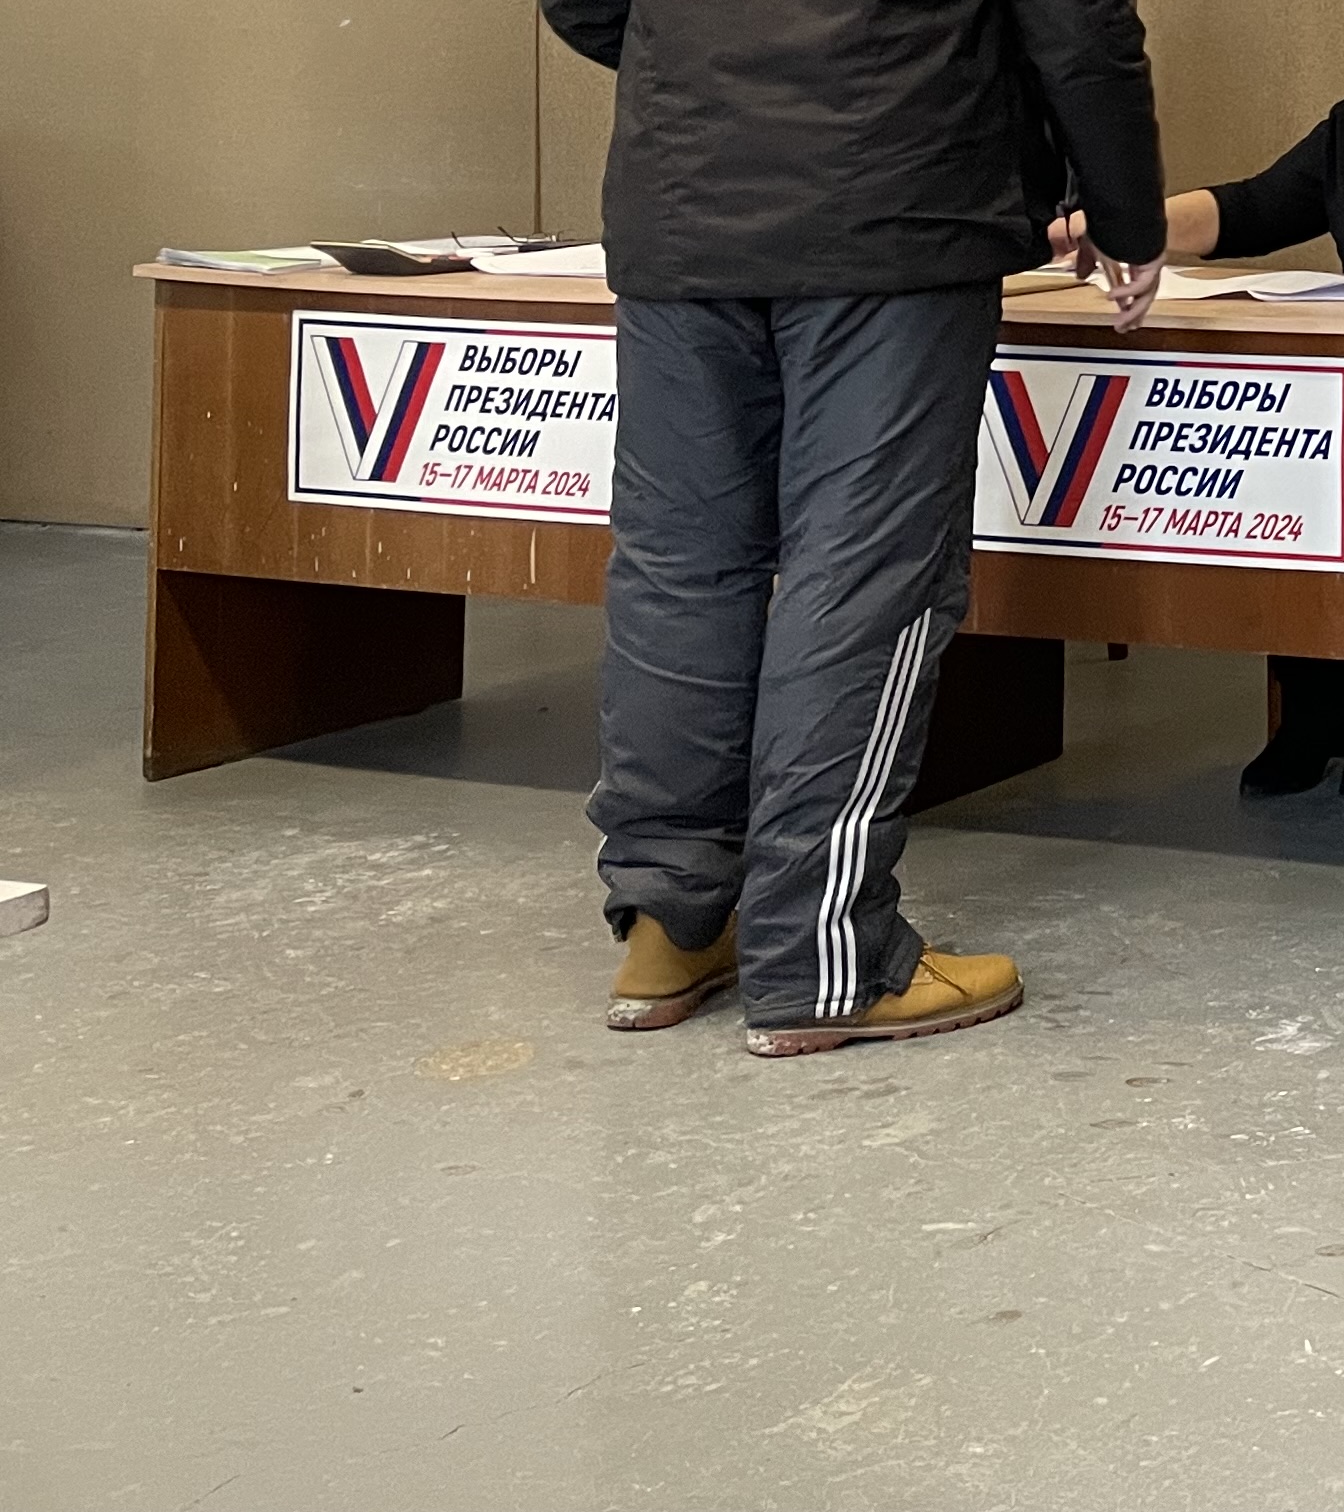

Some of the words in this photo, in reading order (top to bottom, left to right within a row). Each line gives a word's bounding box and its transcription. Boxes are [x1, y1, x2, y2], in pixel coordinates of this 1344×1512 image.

[458, 344, 582, 378] ВЫБОРЫ
[444, 384, 616, 422] ПРЕЗИДЕНТА
[1145, 378, 1291, 414] ВЫБОРЫ
[429, 424, 541, 458] РОССИИ
[1128, 421, 1333, 461] ПРЕЗИДЕНТА
[472, 465, 540, 494] МАРТА
[541, 471, 591, 498] 2024
[1112, 464, 1244, 499] РОССИИ
[1164, 509, 1242, 537] МАРТА
[1245, 513, 1304, 542] 2024
